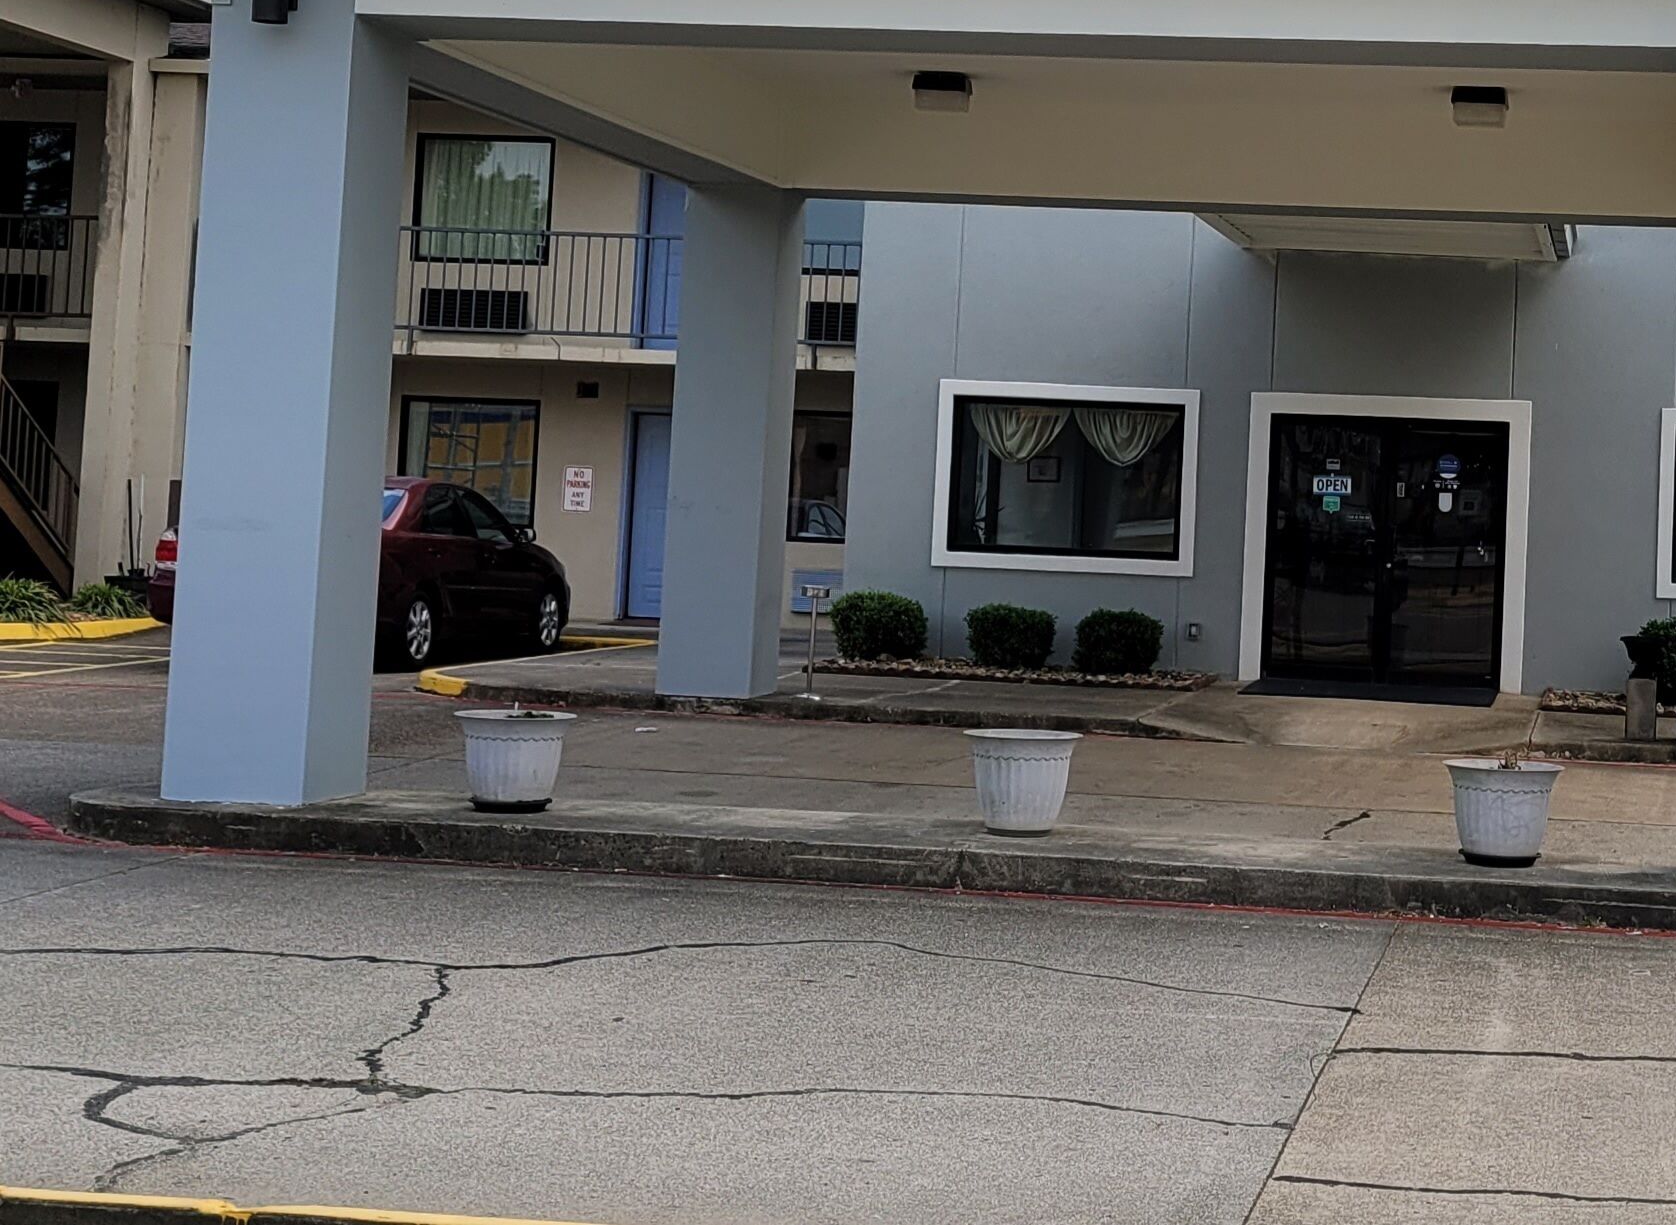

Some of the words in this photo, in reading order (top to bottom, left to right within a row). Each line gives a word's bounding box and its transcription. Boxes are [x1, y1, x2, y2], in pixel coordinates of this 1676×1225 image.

[573, 470, 585, 479] NO
[566, 480, 591, 489] PARKING
[1316, 479, 1348, 492] OPEN
